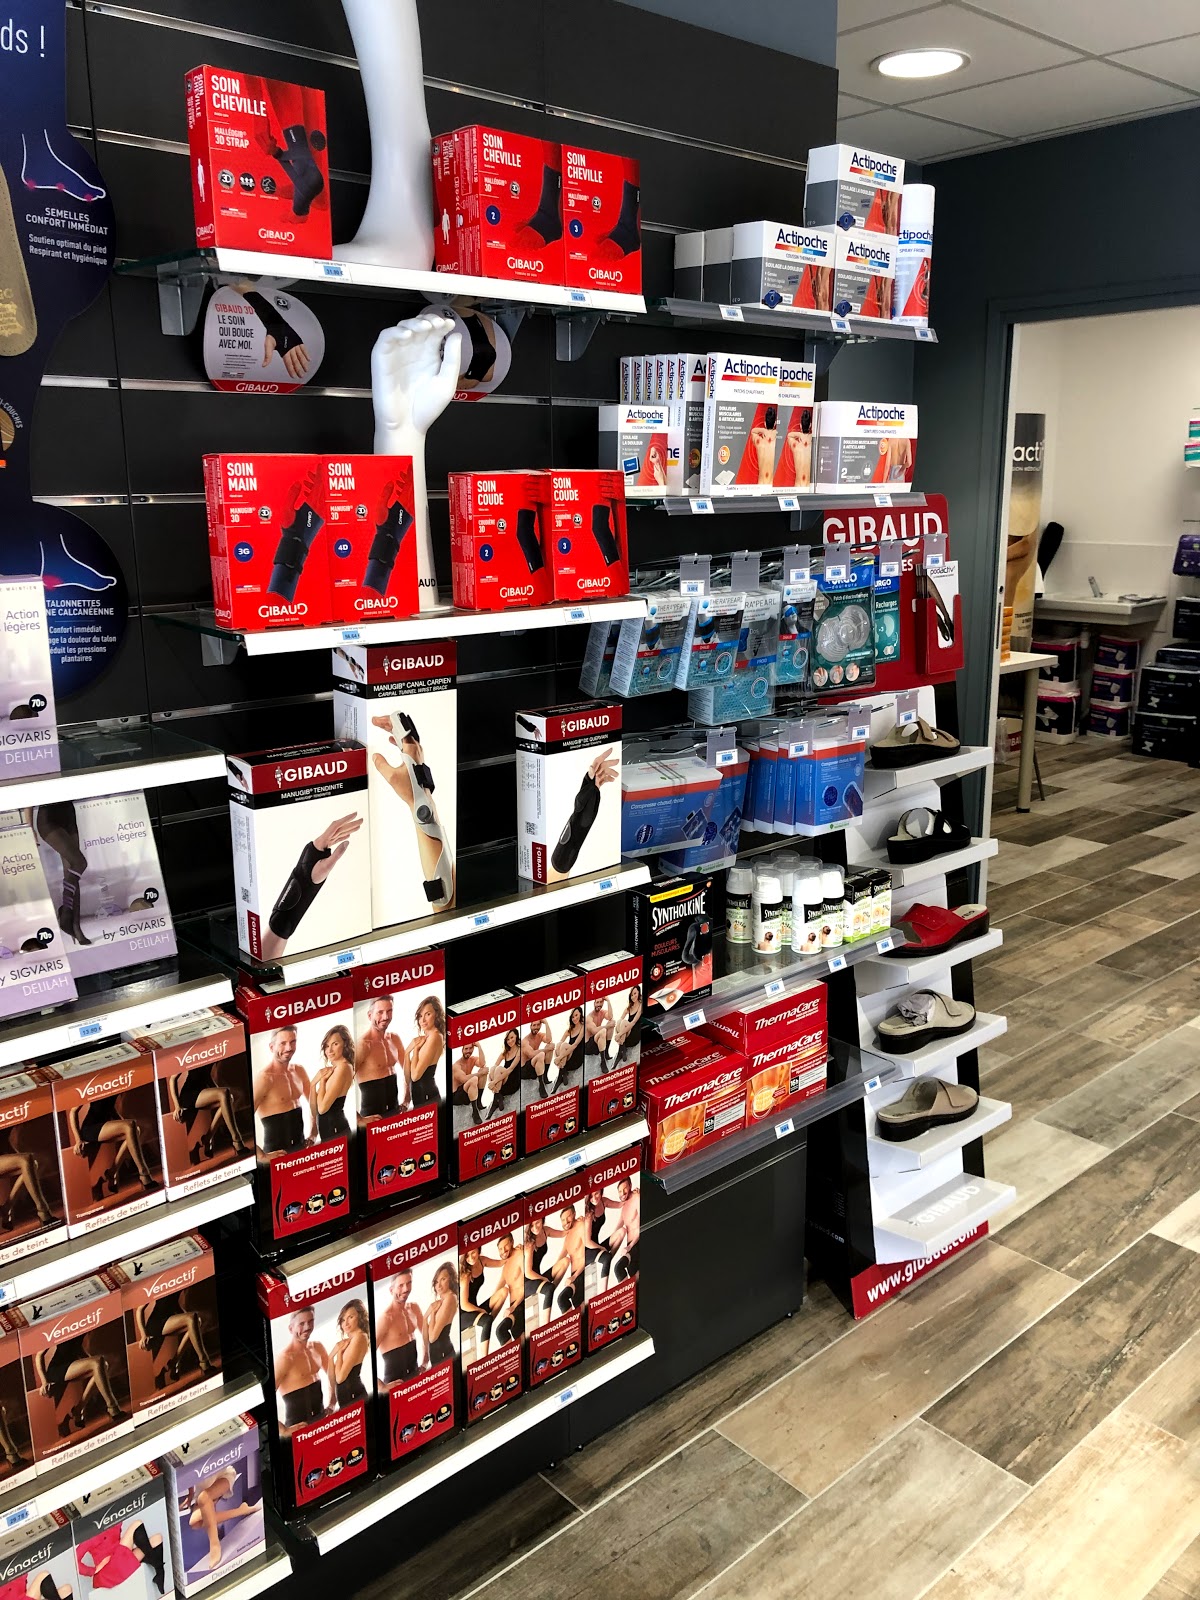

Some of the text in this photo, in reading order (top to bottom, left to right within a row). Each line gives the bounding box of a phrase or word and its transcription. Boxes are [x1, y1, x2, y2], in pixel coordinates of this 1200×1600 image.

[211, 75, 240, 95] SOIN
[212, 93, 267, 117] CHEVILLE
[215, 135, 250, 149] 3D STRAP
[483, 133, 503, 150] SOIN
[484, 148, 521, 168] CHEVILLE
[567, 152, 586, 167] SOIN
[851, 151, 897, 176] Actipoche
[567, 165, 603, 184] CHEVILLE
[45, 207, 90, 222] SEMELLES
[26, 213, 108, 236] CONFORT IMMÉDIAT
[29, 233, 107, 255] Soutien optimal du pied
[258, 228, 295, 243] GIBAUD
[777, 228, 827, 250] Actipoche
[899, 230, 933, 241] ctipoch
[30, 245, 62, 258] Respirant
[848, 241, 890, 262] Actipoche
[507, 256, 544, 273] GIBAUD
[588, 267, 622, 282] GIBAUD
[217, 314, 245, 325] LE SOIN
[219, 326, 254, 339] QUI BOUGE
[218, 338, 253, 351] AVEC MOI.
[724, 358, 778, 377] Actipoche
[780, 366, 813, 382] ipoche
[236, 382, 278, 394] GIBAUD
[627, 409, 664, 419] Actipoche
[858, 405, 904, 420] Actipoche
[227, 462, 254, 477] SOIN
[328, 463, 352, 477] SOIN
[228, 477, 258, 491] MAIN
[329, 477, 355, 490] MAIN
[477, 480, 496, 493] SOIN
[553, 477, 571, 489] SOIN
[478, 493, 504, 506] COUDE
[553, 490, 579, 502] COUDE
[230, 514, 240, 523] 3D
[331, 512, 339, 521] 3D
[418, 578, 436, 588] AUD
[500, 585, 534, 598] GIBAUD
[577, 576, 610, 589] GIBAUD
[46, 600, 101, 608] TALONNETTES
[58, 607, 114, 616] CALCANÉENNE
[258, 602, 308, 618] GIBAUD
[354, 596, 398, 611] GIBAUD
[6, 610, 39, 620] Action
[4, 622, 40, 634] légères
[49, 625, 102, 634] Confort immédiat
[67, 635, 91, 643] douleur
[61, 654, 92, 664] plantaires
[77, 646, 107, 656] pressions
[391, 655, 444, 671] GIBAUD
[406, 680, 425, 688] CANAL
[426, 677, 451, 687] CARPIEN
[567, 715, 609, 732] GIBAUD
[5, 748, 54, 765] DELILAH
[284, 760, 348, 782] GIBAUD
[314, 783, 344, 794] TENDINITE
[117, 820, 145, 832] Action
[83, 829, 147, 850] jambes légères
[2, 853, 33, 864] Action
[1, 862, 36, 876] légères
[103, 917, 167, 941] by SIGVARIS
[129, 933, 170, 951] DELILAH
[10, 960, 64, 981] SIGVARIS
[372, 964, 434, 989] GIBAUD
[596, 968, 640, 991] GIBAUD
[23, 976, 69, 996] DELILAH
[274, 991, 342, 1020] GIBAUD
[532, 989, 581, 1014] GIBAUD
[464, 1010, 517, 1037] GIBAUD
[755, 998, 819, 1030] ThermaCare
[175, 1040, 229, 1067] Venactif
[752, 1030, 823, 1067] ThermaCare
[592, 1066, 634, 1086] Thermotherapy
[646, 1052, 720, 1085] ThermaCare
[75, 1070, 135, 1099] Venactif
[664, 1067, 741, 1109] ThermaCare
[530, 1090, 576, 1112] Thermotherapy
[371, 1111, 434, 1135] Thermotherapy
[463, 1115, 513, 1139] Thermotherapy
[275, 1144, 344, 1171] Thermotherapy
[183, 1165, 242, 1194] Reflets de teint
[593, 1157, 638, 1184] GIBAUD
[534, 1185, 582, 1214] GIBAUD
[85, 1200, 149, 1231] Reflets de teint
[469, 1212, 520, 1243] GIBAUD
[12, 1244, 25, 1256] de
[26, 1237, 49, 1251] teint
[393, 1233, 448, 1266] GIBAUD
[143, 1266, 198, 1298] Venactif
[590, 1282, 635, 1308] Thermotherapy
[42, 1308, 103, 1343] Venactif
[532, 1313, 580, 1341] Thermotherapy
[469, 1344, 520, 1375] Thermotherapy
[393, 1366, 450, 1399] Thermotherapy
[147, 1384, 208, 1417] Reflets de teint
[296, 1407, 361, 1442] Thermotherapy
[51, 1430, 118, 1465] Reflets de teint
[195, 1443, 244, 1478] Venactif
[94, 1493, 148, 1530] Venactif
[211, 1557, 245, 1581] Douceur
